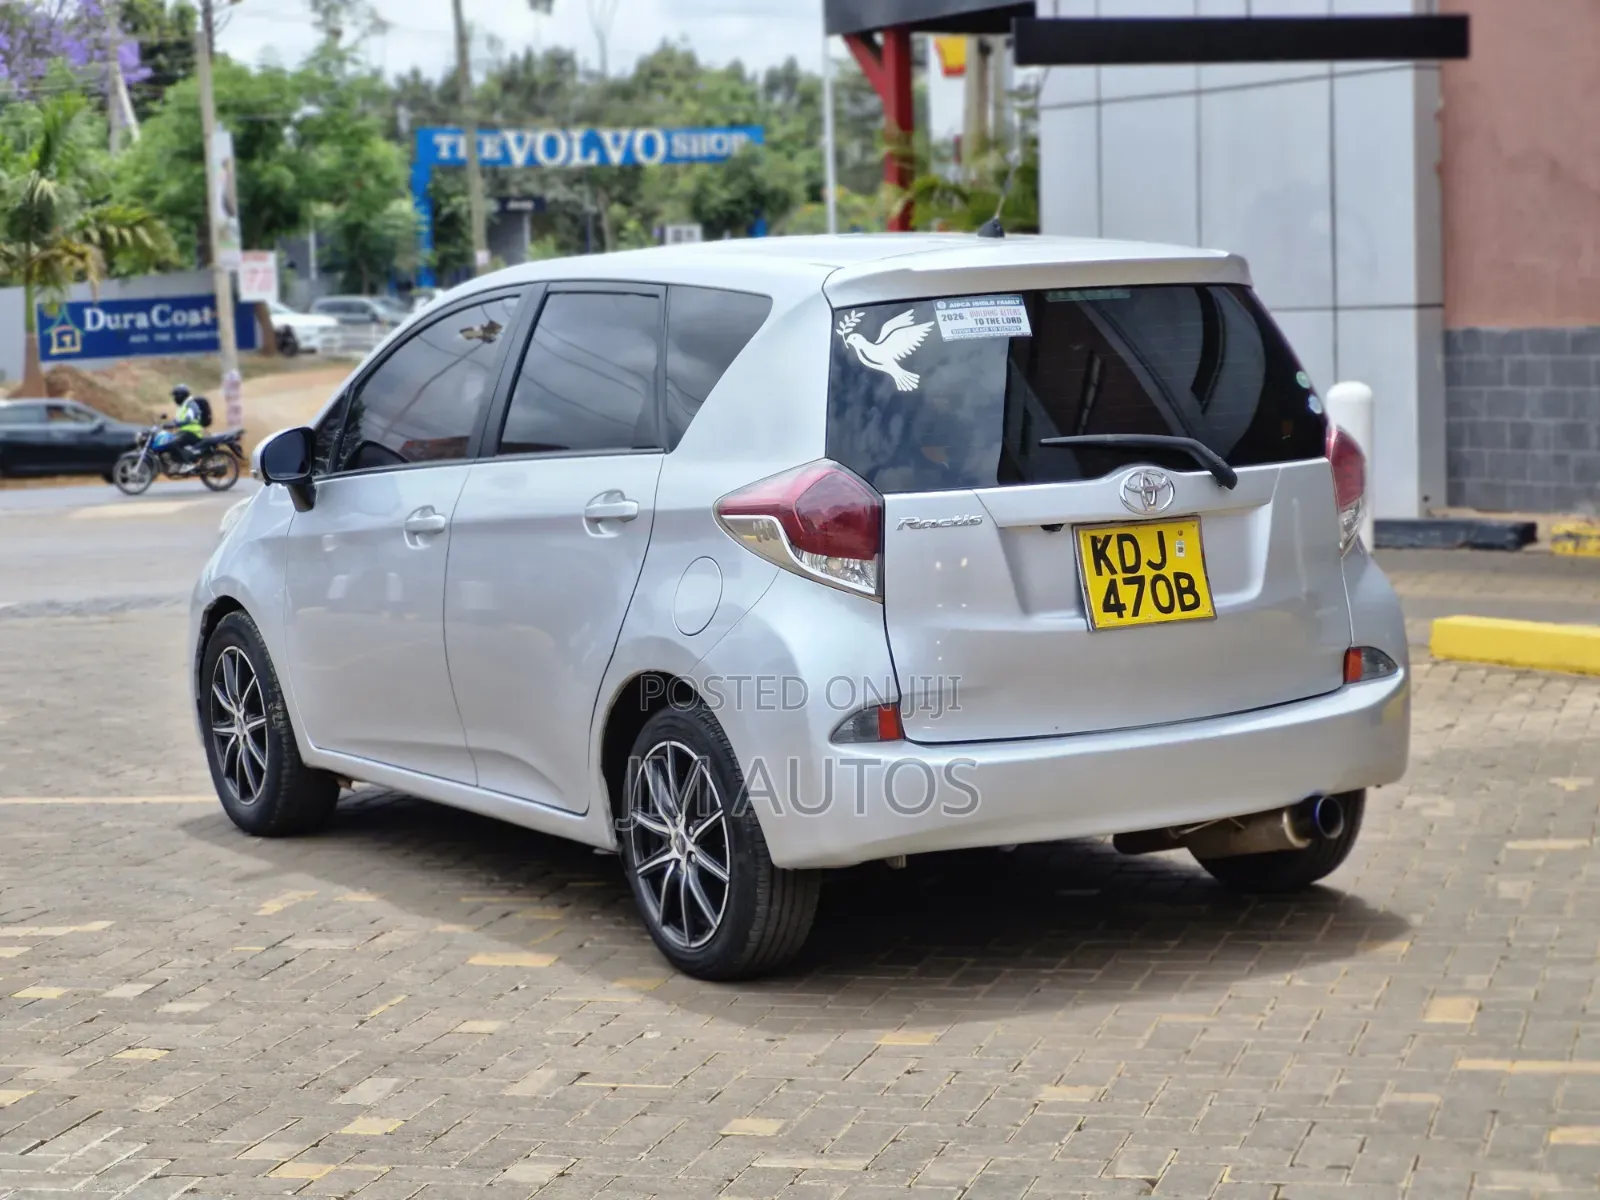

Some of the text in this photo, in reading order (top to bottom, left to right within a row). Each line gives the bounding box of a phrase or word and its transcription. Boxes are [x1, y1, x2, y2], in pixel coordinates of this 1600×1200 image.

[502, 129, 667, 166] VOLVO
[671, 132, 750, 158] SHOP
[974, 316, 1022, 326] TO THE LORD
[896, 513, 984, 531] Ractis
[1090, 530, 1168, 577] KDJ
[1102, 571, 1201, 618] 470B
